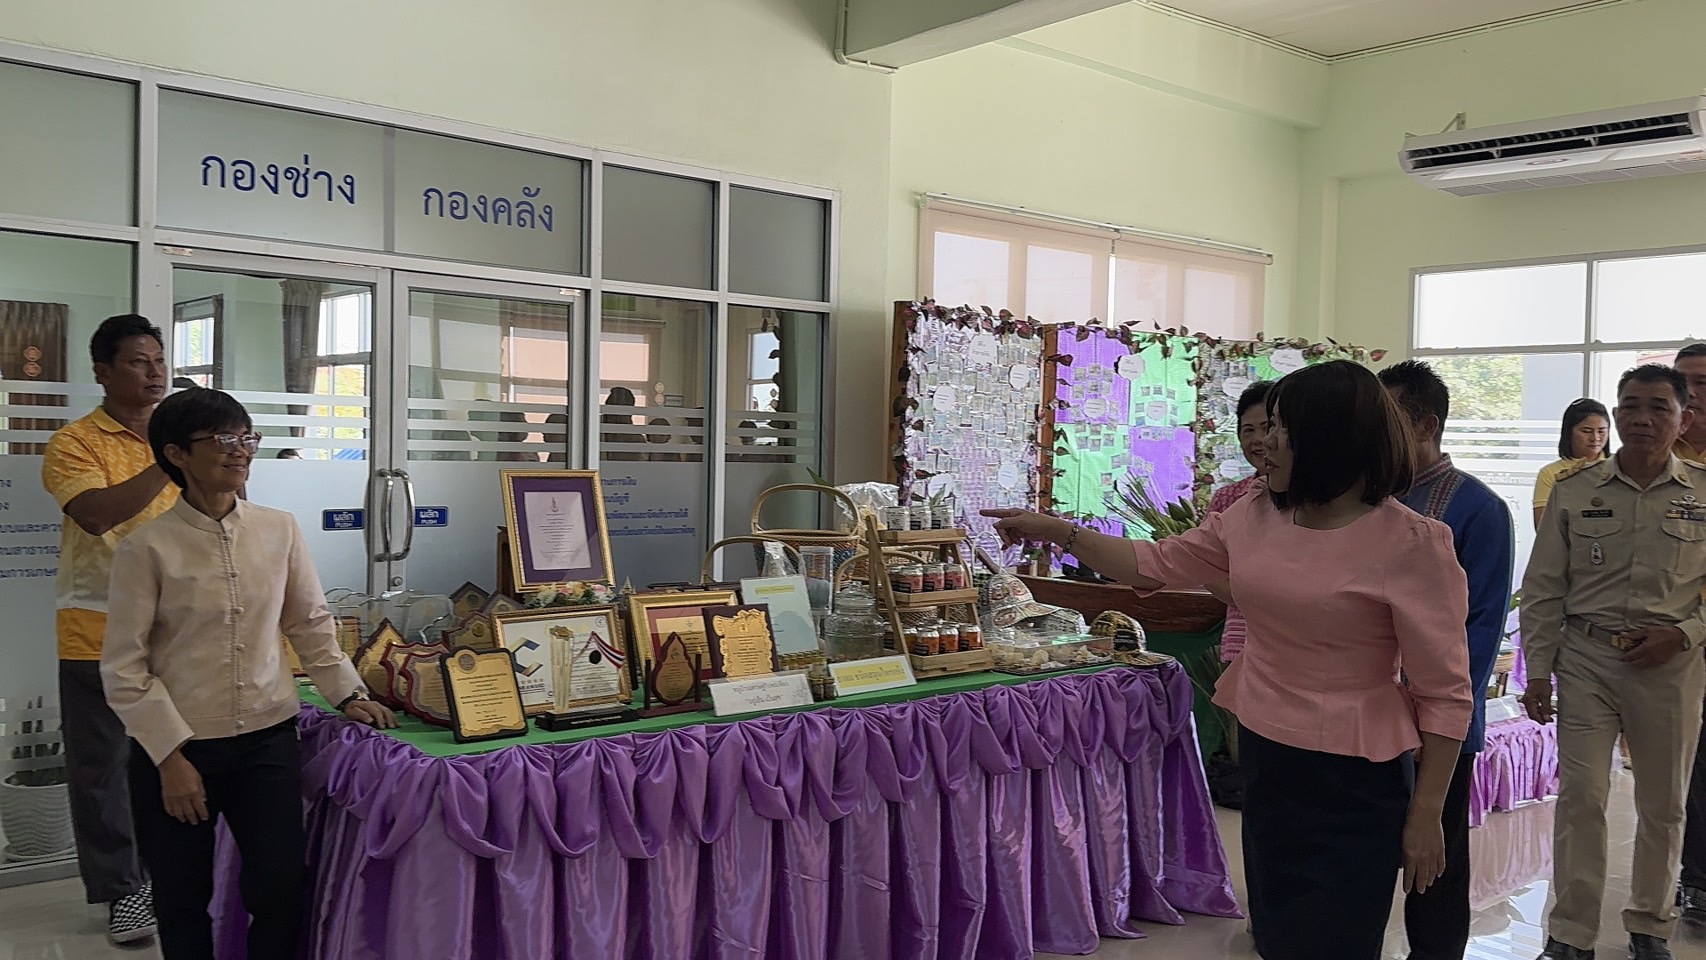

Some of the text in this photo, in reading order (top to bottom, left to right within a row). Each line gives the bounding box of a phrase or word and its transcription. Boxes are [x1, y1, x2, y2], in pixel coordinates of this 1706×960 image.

[201, 154, 355, 204] กองช่าง
[423, 186, 553, 232] กองคลัง
